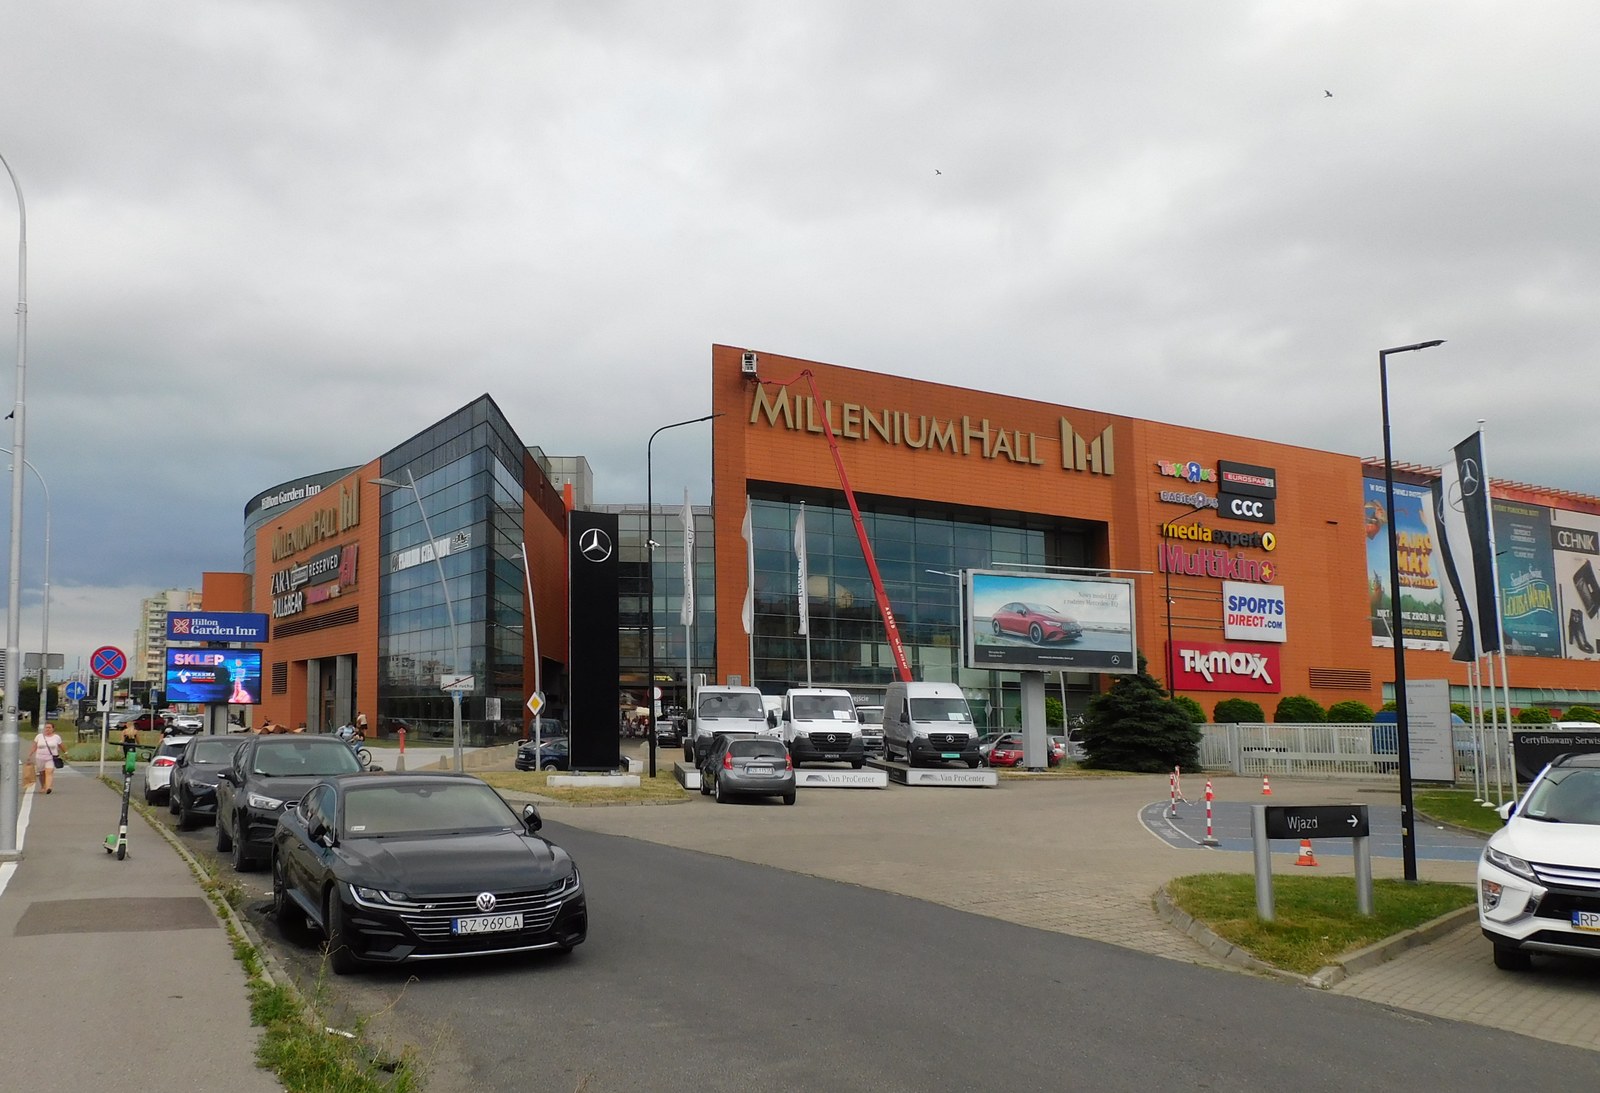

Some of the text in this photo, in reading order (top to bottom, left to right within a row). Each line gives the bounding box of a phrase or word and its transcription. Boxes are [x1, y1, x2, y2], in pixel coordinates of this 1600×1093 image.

[279, 487, 305, 504] Garden
[305, 484, 321, 497] Inn
[1231, 499, 1264, 518] CCC
[1557, 530, 1595, 551] OCHNIK
[308, 554, 339, 577] RESERVED
[1158, 543, 1275, 583] Multikino
[270, 569, 291, 596] ZARA
[272, 591, 303, 618] PULL&BEAR
[1228, 595, 1284, 615] SPORTS
[190, 625, 257, 636] Garden Inn
[191, 618, 219, 626] Hilton
[174, 653, 225, 666] SKLEP
[1520, 735, 1573, 746] Certyfikowany
[827, 774, 875, 783] Van ProCenter
[940, 773, 985, 782] Van ProCenter
[1287, 815, 1318, 832] Wjazd
[460, 915, 520, 933] RZ 969CA
